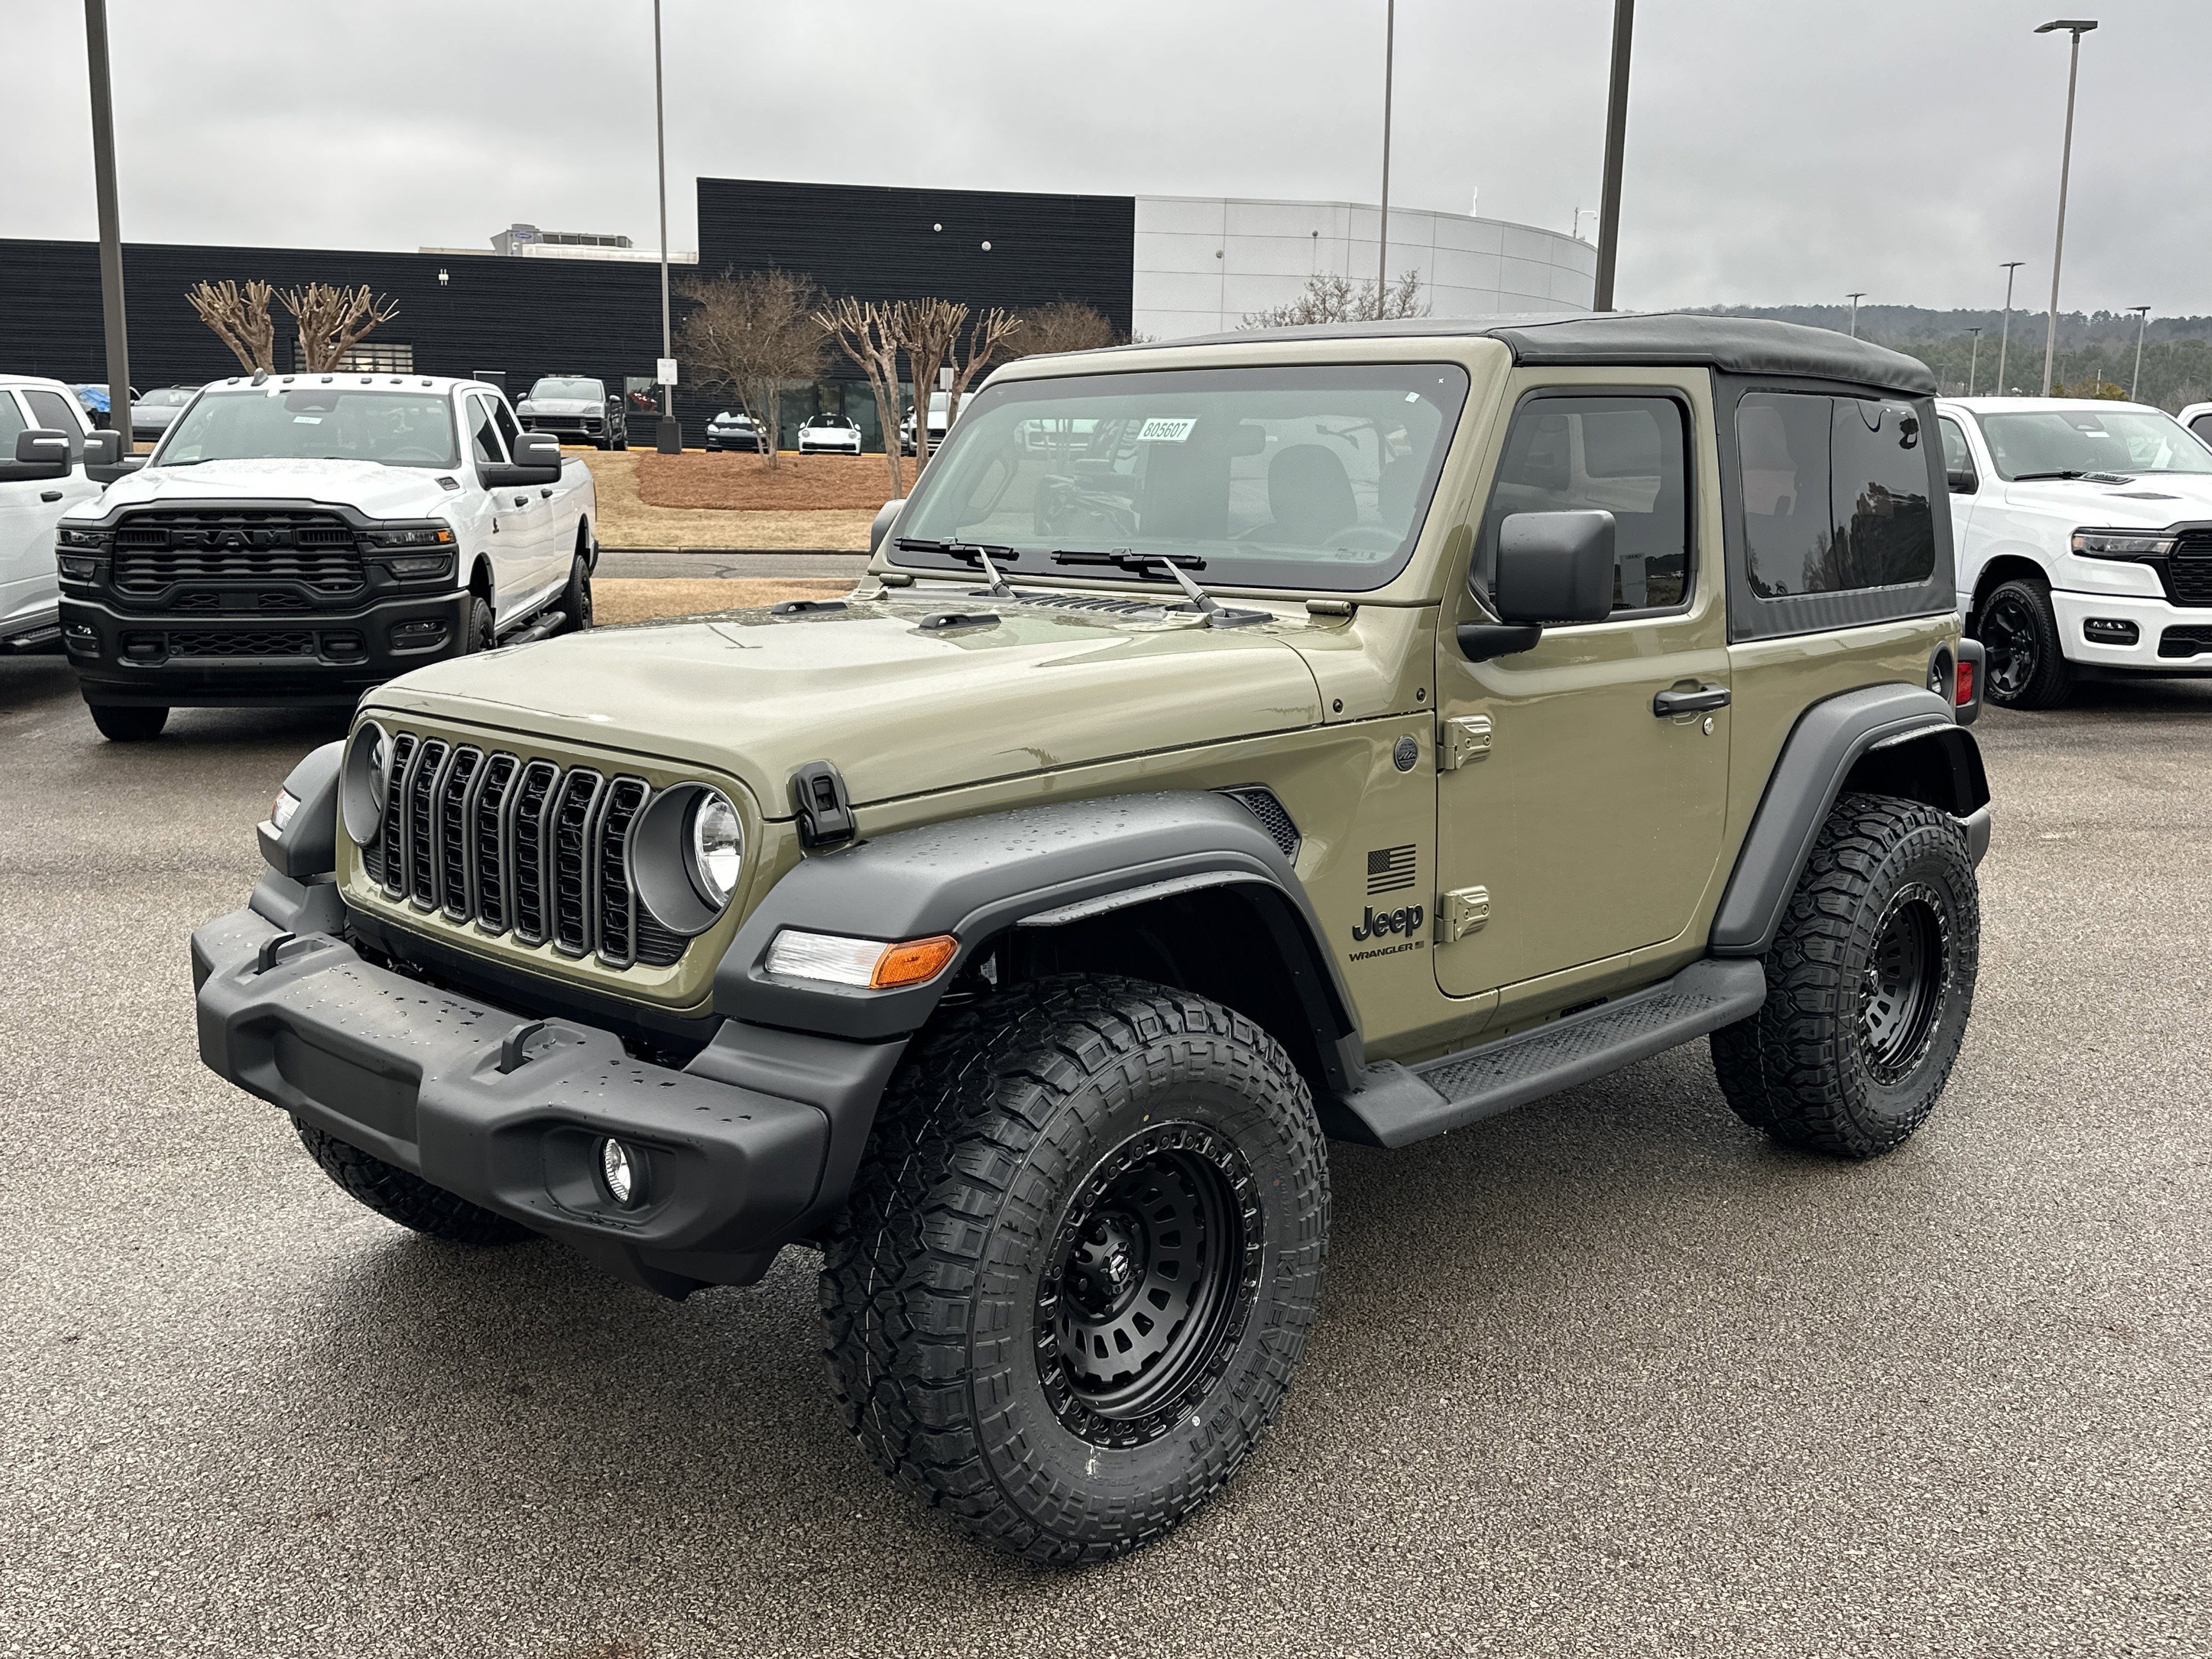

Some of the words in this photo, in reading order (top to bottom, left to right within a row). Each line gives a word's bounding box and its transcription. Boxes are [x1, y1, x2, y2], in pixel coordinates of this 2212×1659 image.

[1143, 422, 1188, 437] 805607
[172, 529, 292, 546] RAM
[1352, 904, 1424, 941] Jeep
[1348, 943, 1413, 962] WRANGLER
[1232, 1250, 1297, 1402] KLEVER
